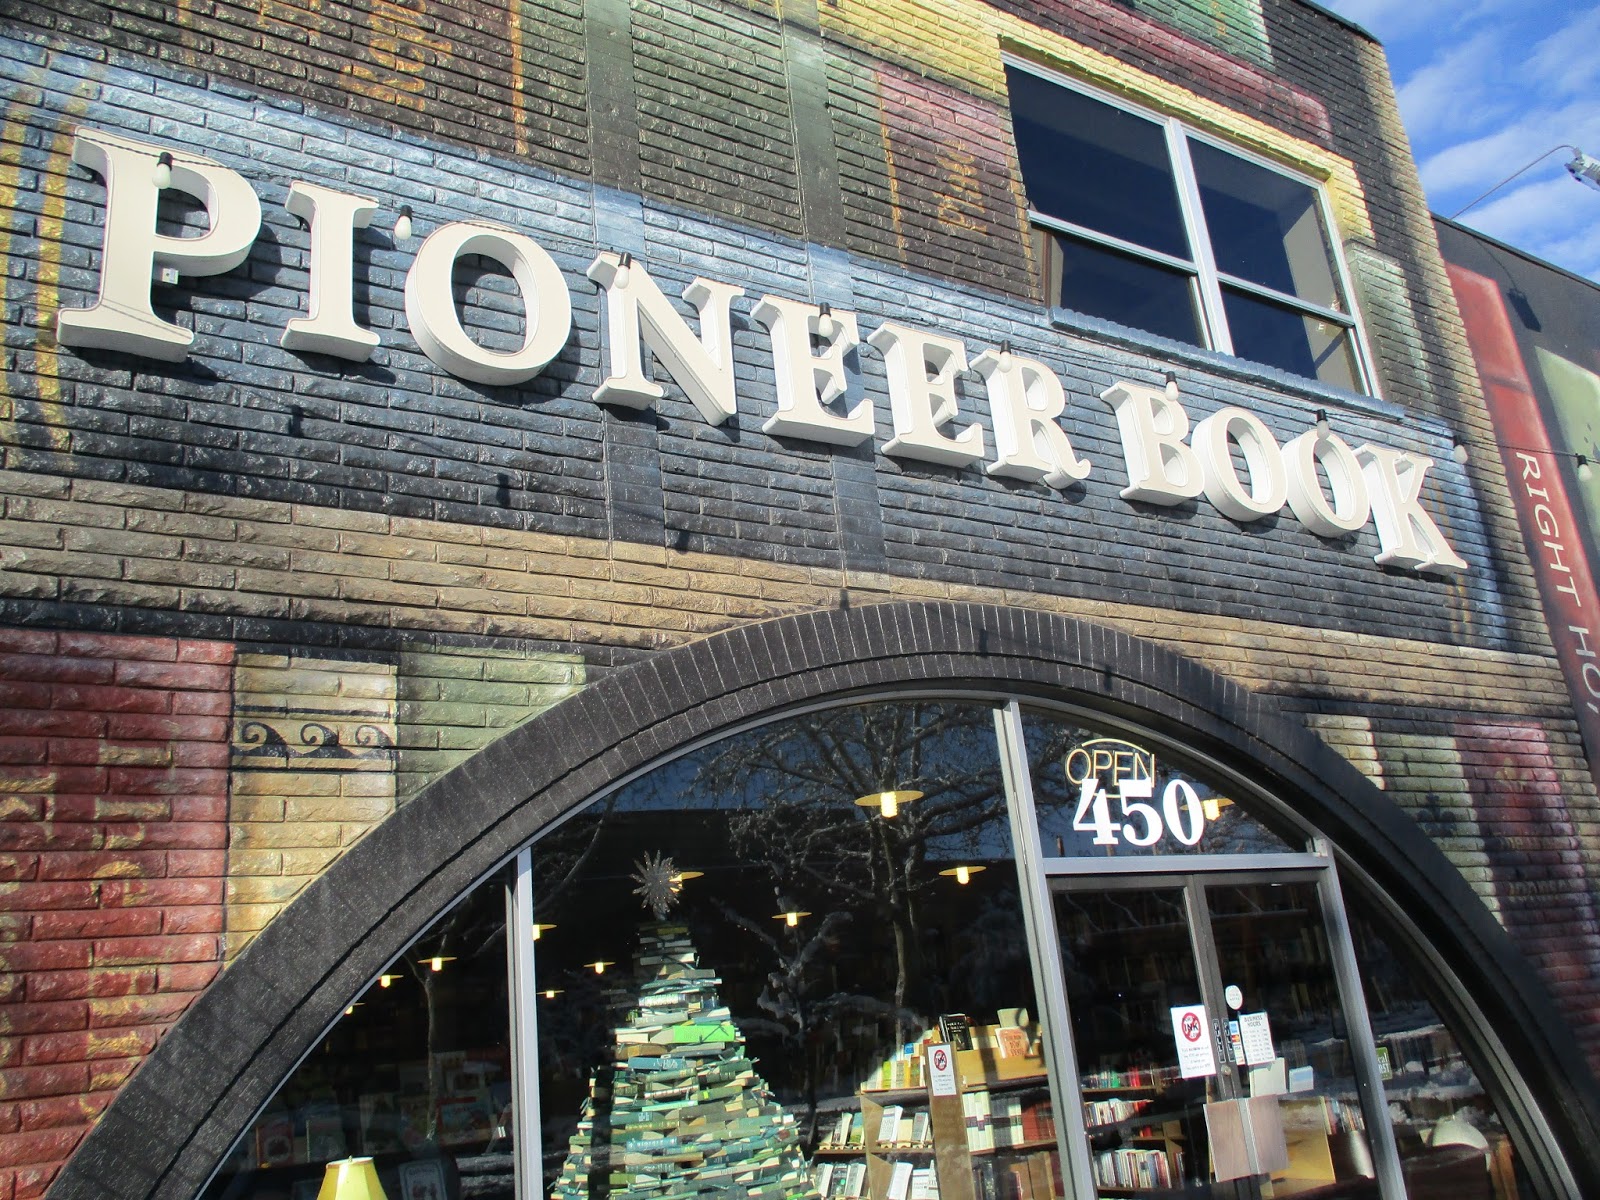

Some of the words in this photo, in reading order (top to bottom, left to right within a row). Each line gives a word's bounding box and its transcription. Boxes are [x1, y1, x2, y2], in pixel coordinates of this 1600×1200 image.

[57, 125, 1091, 489] PIONEER
[1100, 381, 1468, 576] BOOK
[1516, 452, 1581, 607] RIGHT
[1065, 748, 1157, 789] OPEN
[1073, 778, 1205, 847] 450
